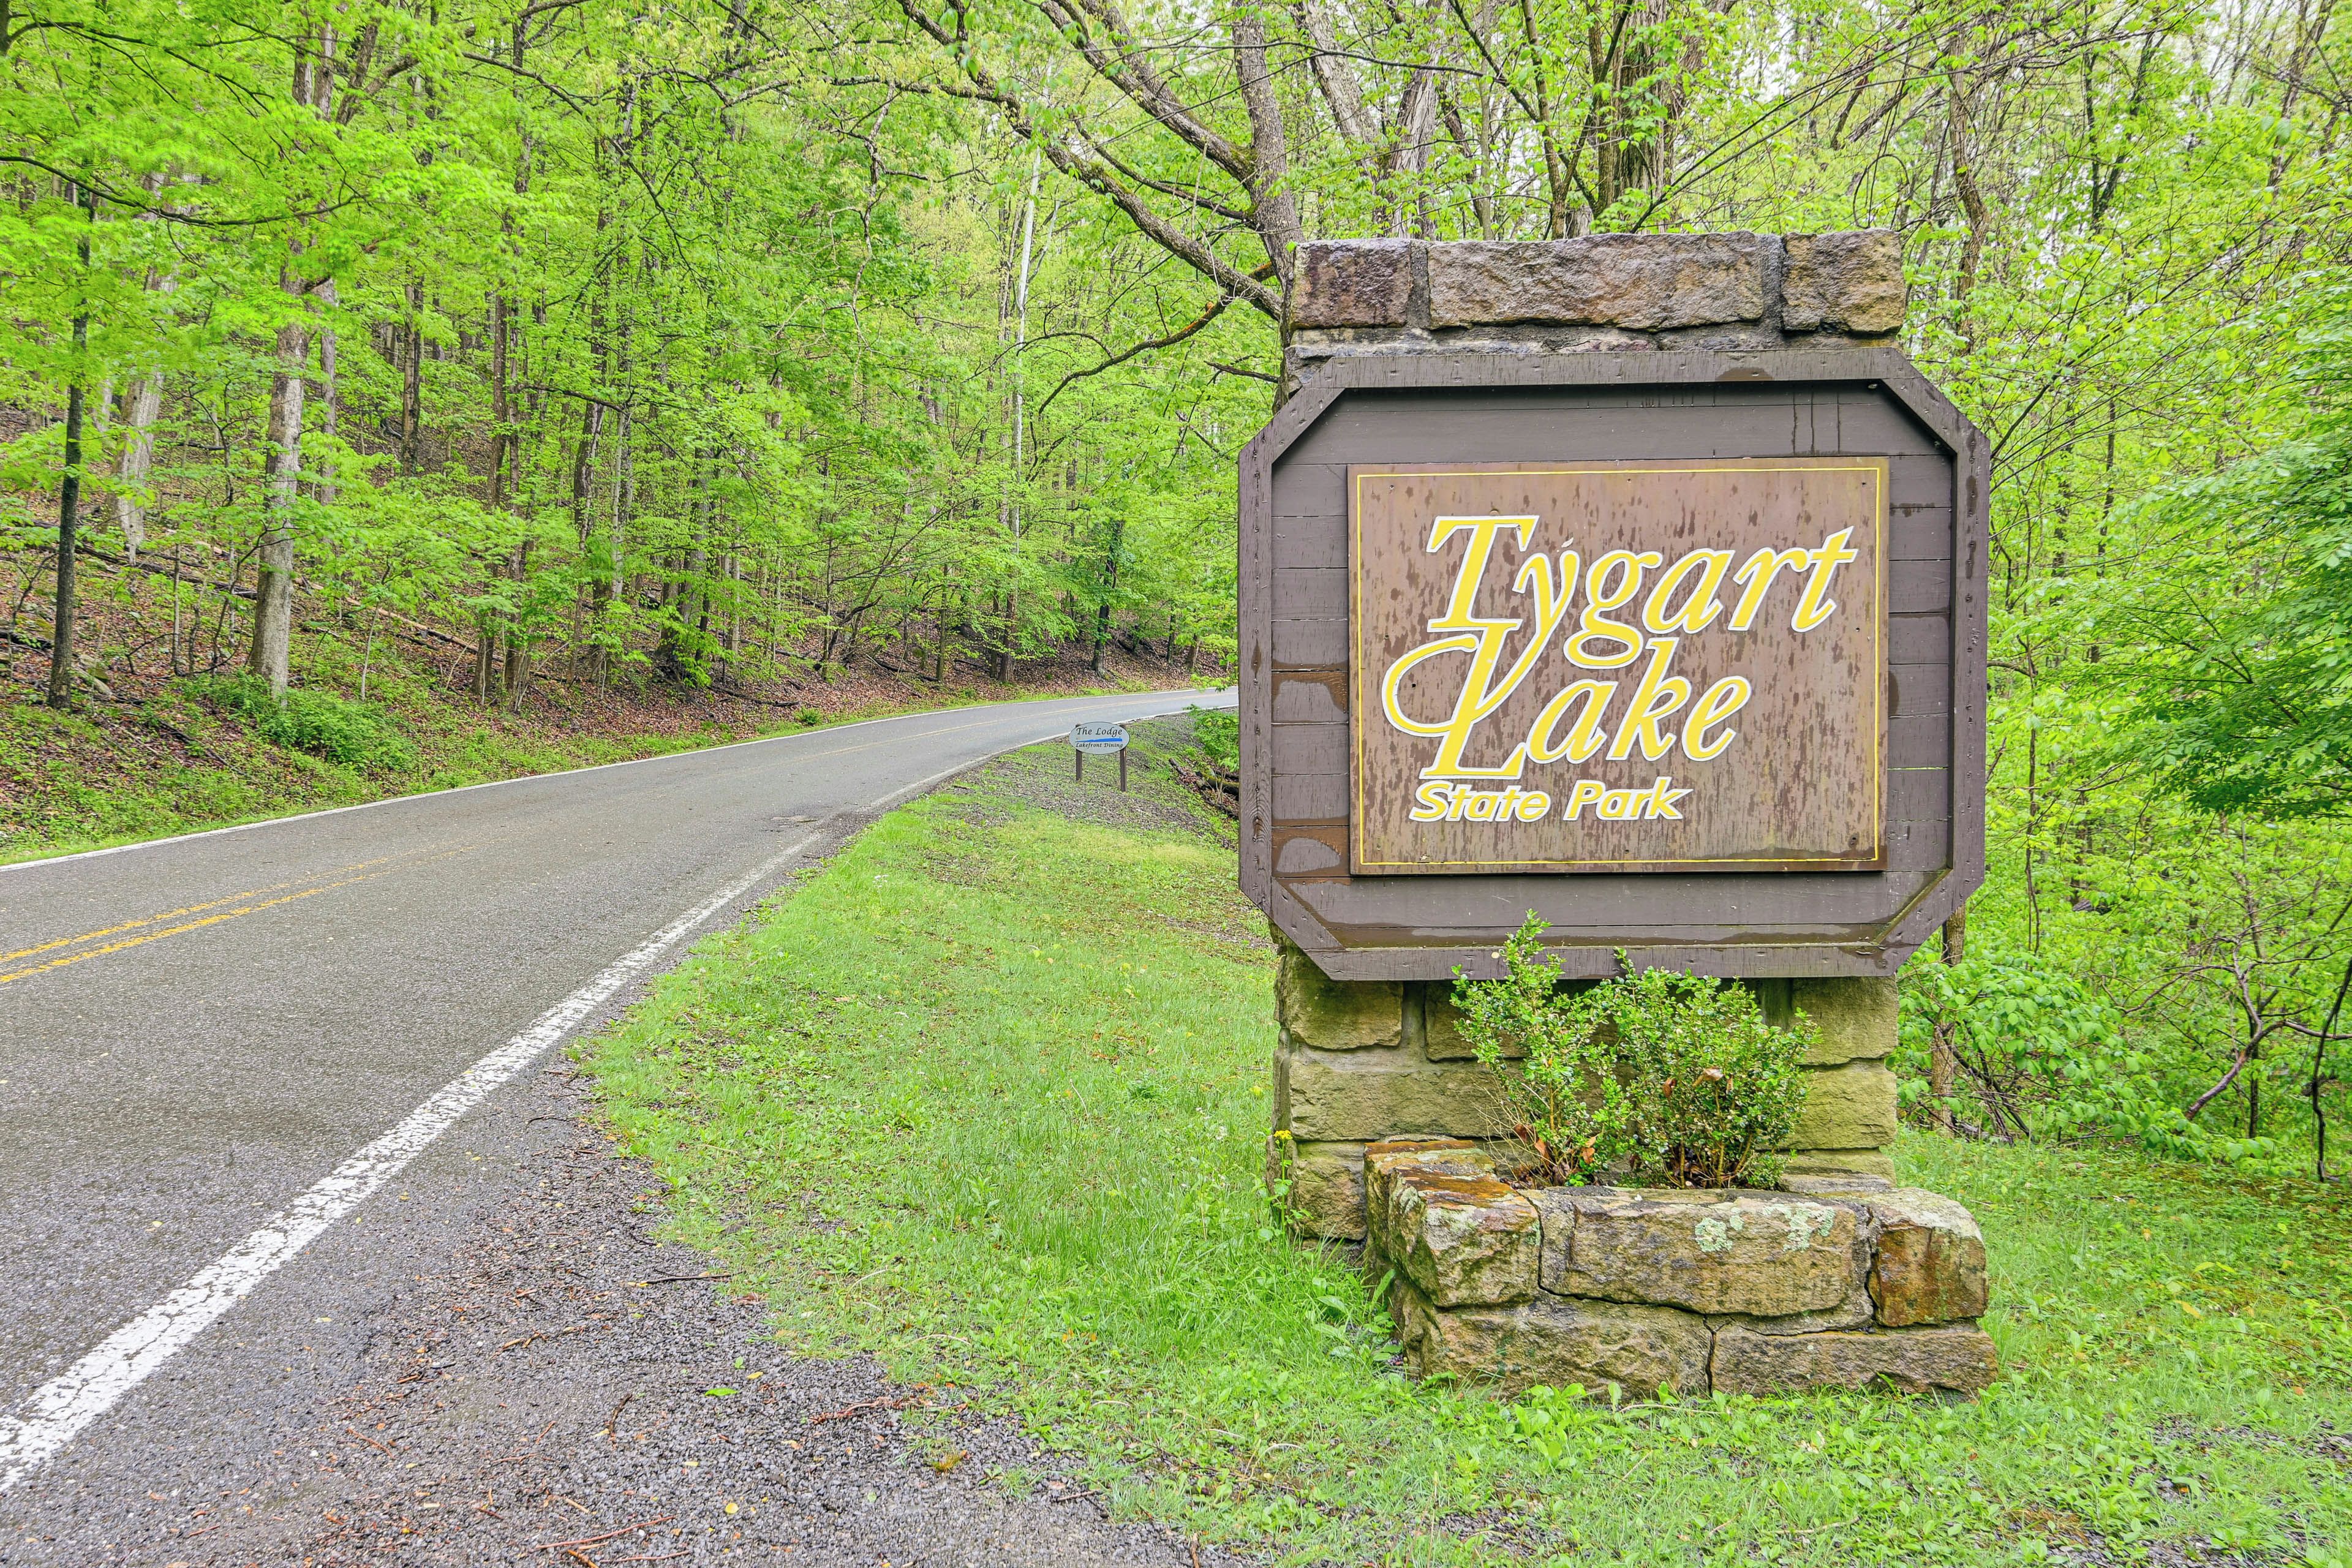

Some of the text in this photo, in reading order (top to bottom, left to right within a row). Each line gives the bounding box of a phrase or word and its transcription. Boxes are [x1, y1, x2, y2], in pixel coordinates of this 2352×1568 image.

[1427, 515, 1859, 713] Tygart
[1076, 726, 1122, 737] The Lodge
[1382, 624, 1752, 780] Lake
[1409, 776, 1693, 823] State Park
